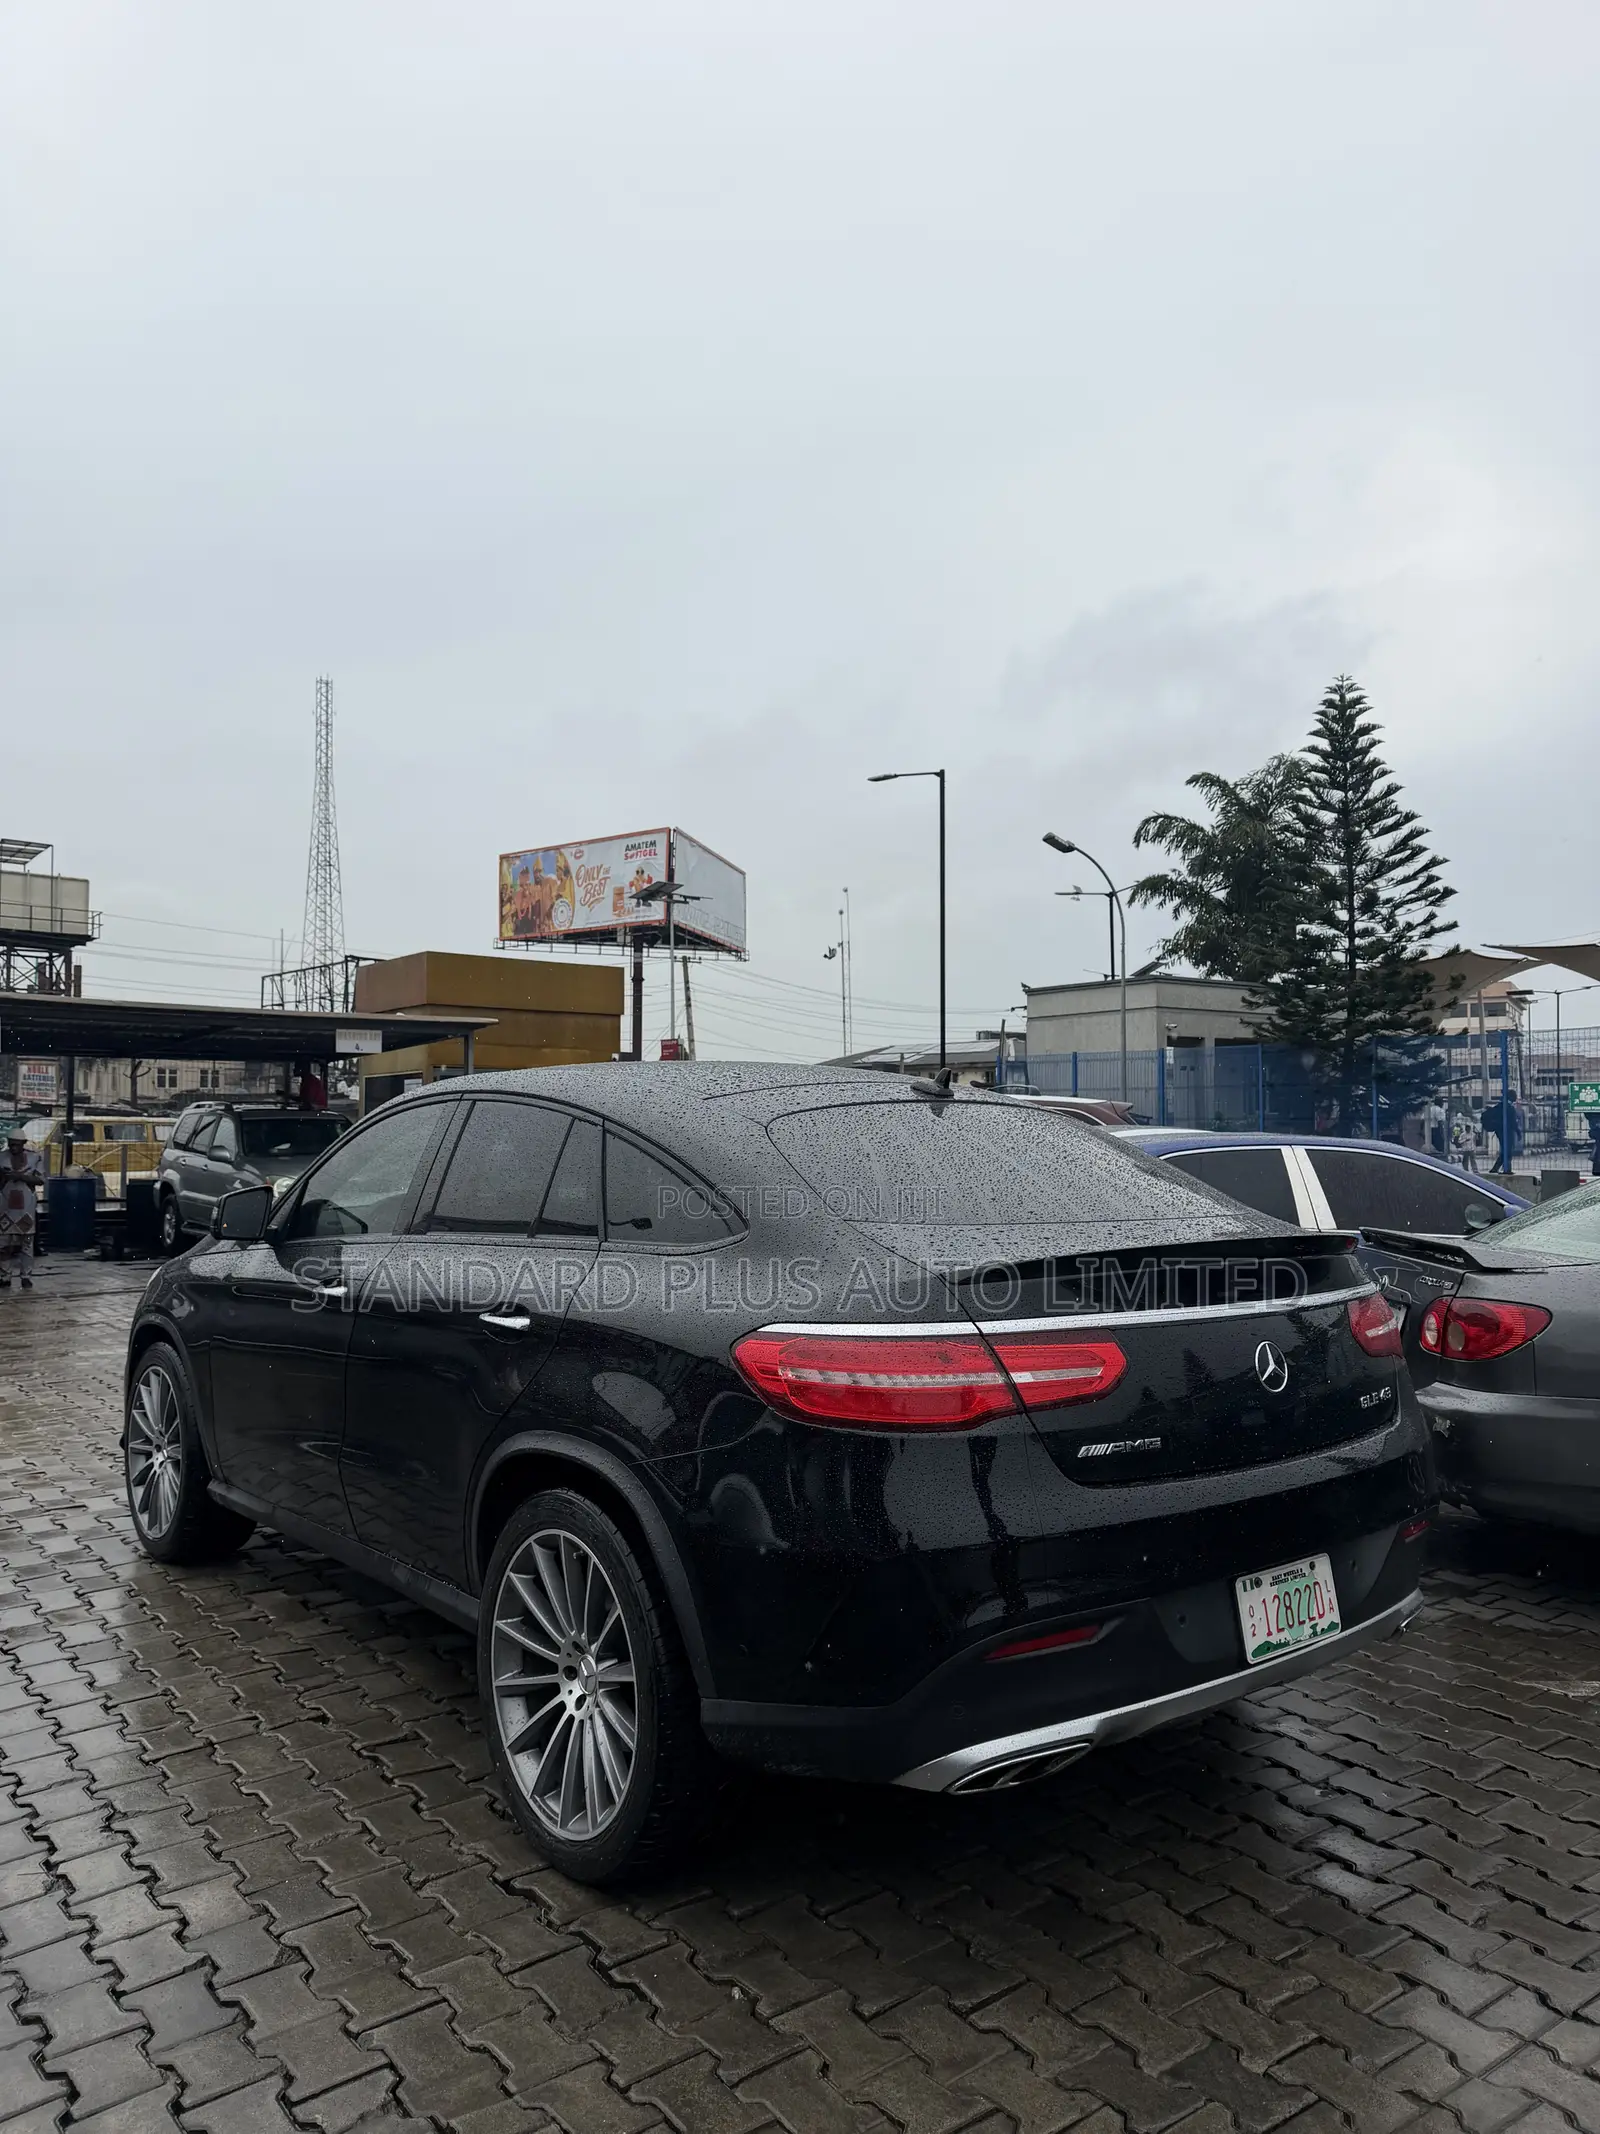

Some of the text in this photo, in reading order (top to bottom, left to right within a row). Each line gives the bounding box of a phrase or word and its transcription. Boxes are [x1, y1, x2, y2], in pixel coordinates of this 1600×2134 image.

[624, 848, 658, 860] SOFTGEL
[625, 840, 657, 852] AMATEM
[575, 864, 603, 888] ONLY
[580, 876, 611, 906] BEST
